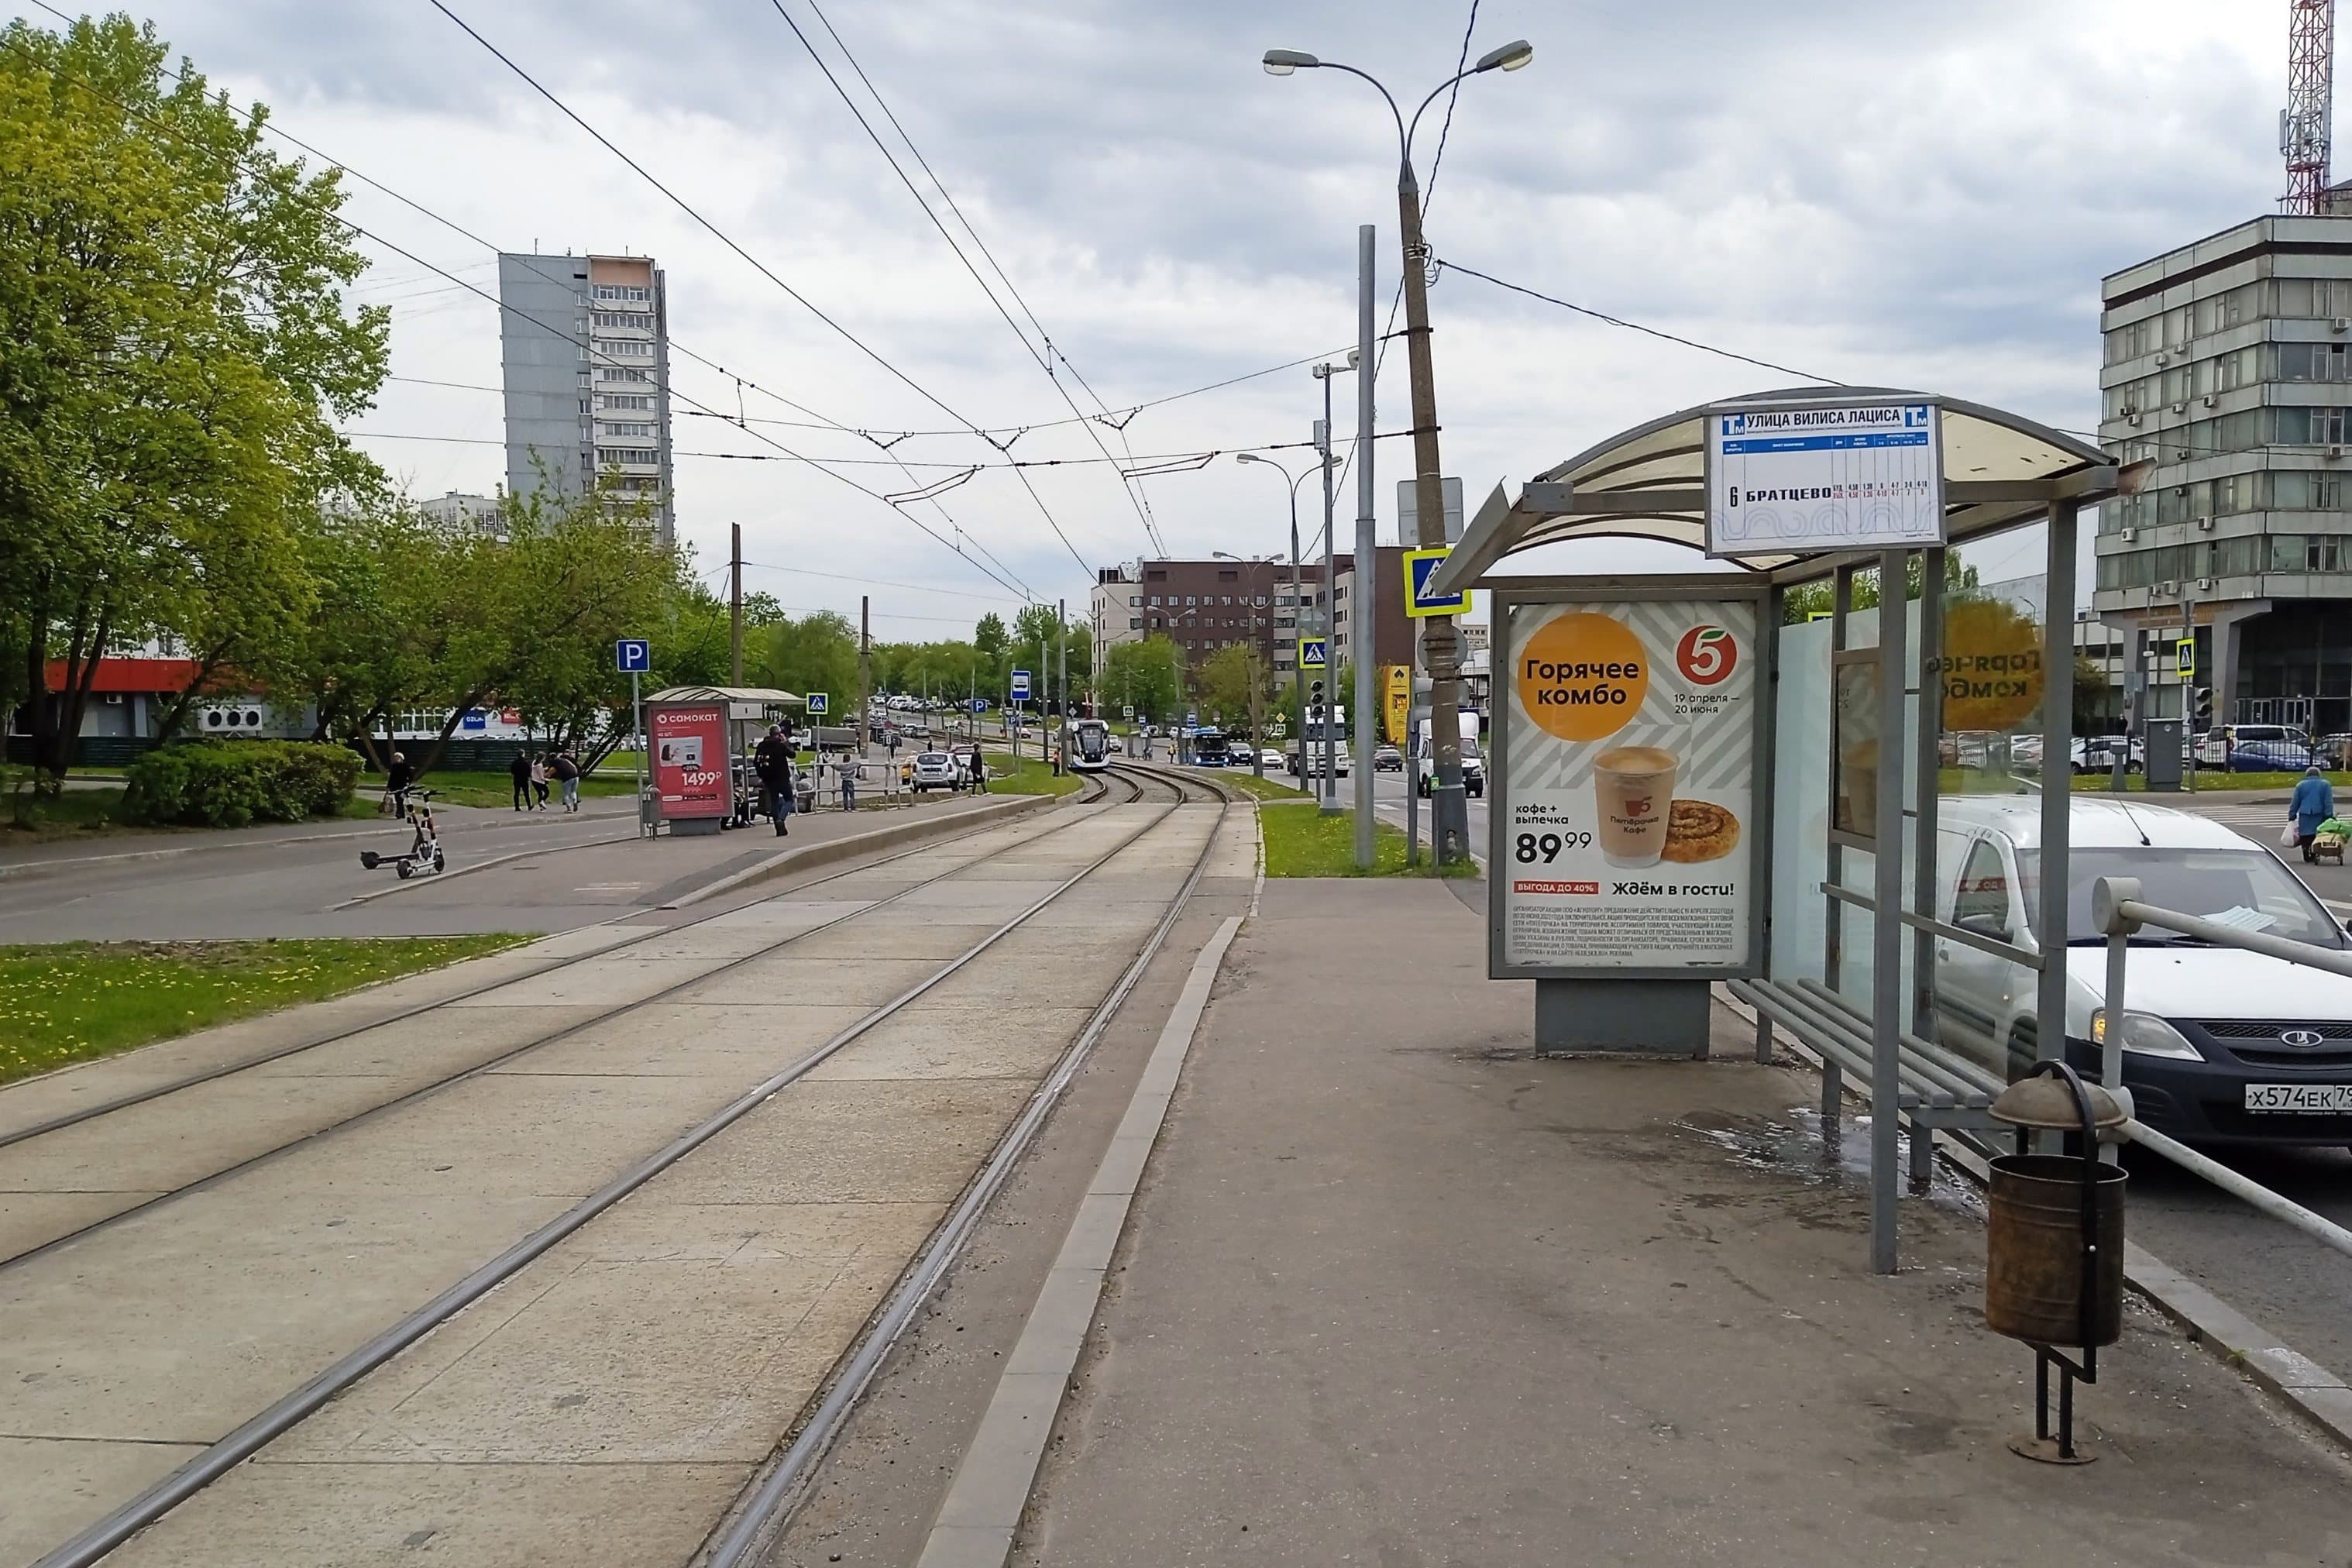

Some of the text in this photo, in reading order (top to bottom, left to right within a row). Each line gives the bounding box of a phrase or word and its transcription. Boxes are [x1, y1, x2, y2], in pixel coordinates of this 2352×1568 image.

[1746, 408, 1900, 428] УЛИЦА ВИЛИСА ЛАЦИСА
[1730, 487, 1831, 507] 6 БРАТЦЕВО
[626, 644, 642, 668] P
[1526, 659, 1640, 686] Горячее
[1537, 683, 1627, 707] комбо
[1674, 694, 1685, 703] 19
[1689, 695, 1728, 704] апреля
[1675, 705, 1687, 714] 20
[1515, 803, 1546, 816] кофе
[1515, 815, 1569, 825] выпечка
[1515, 831, 1592, 864] 89 99
[1518, 882, 1594, 892] ВЫГОДА ДО 40%
[1611, 882, 1734, 896] Ждём в гости!
